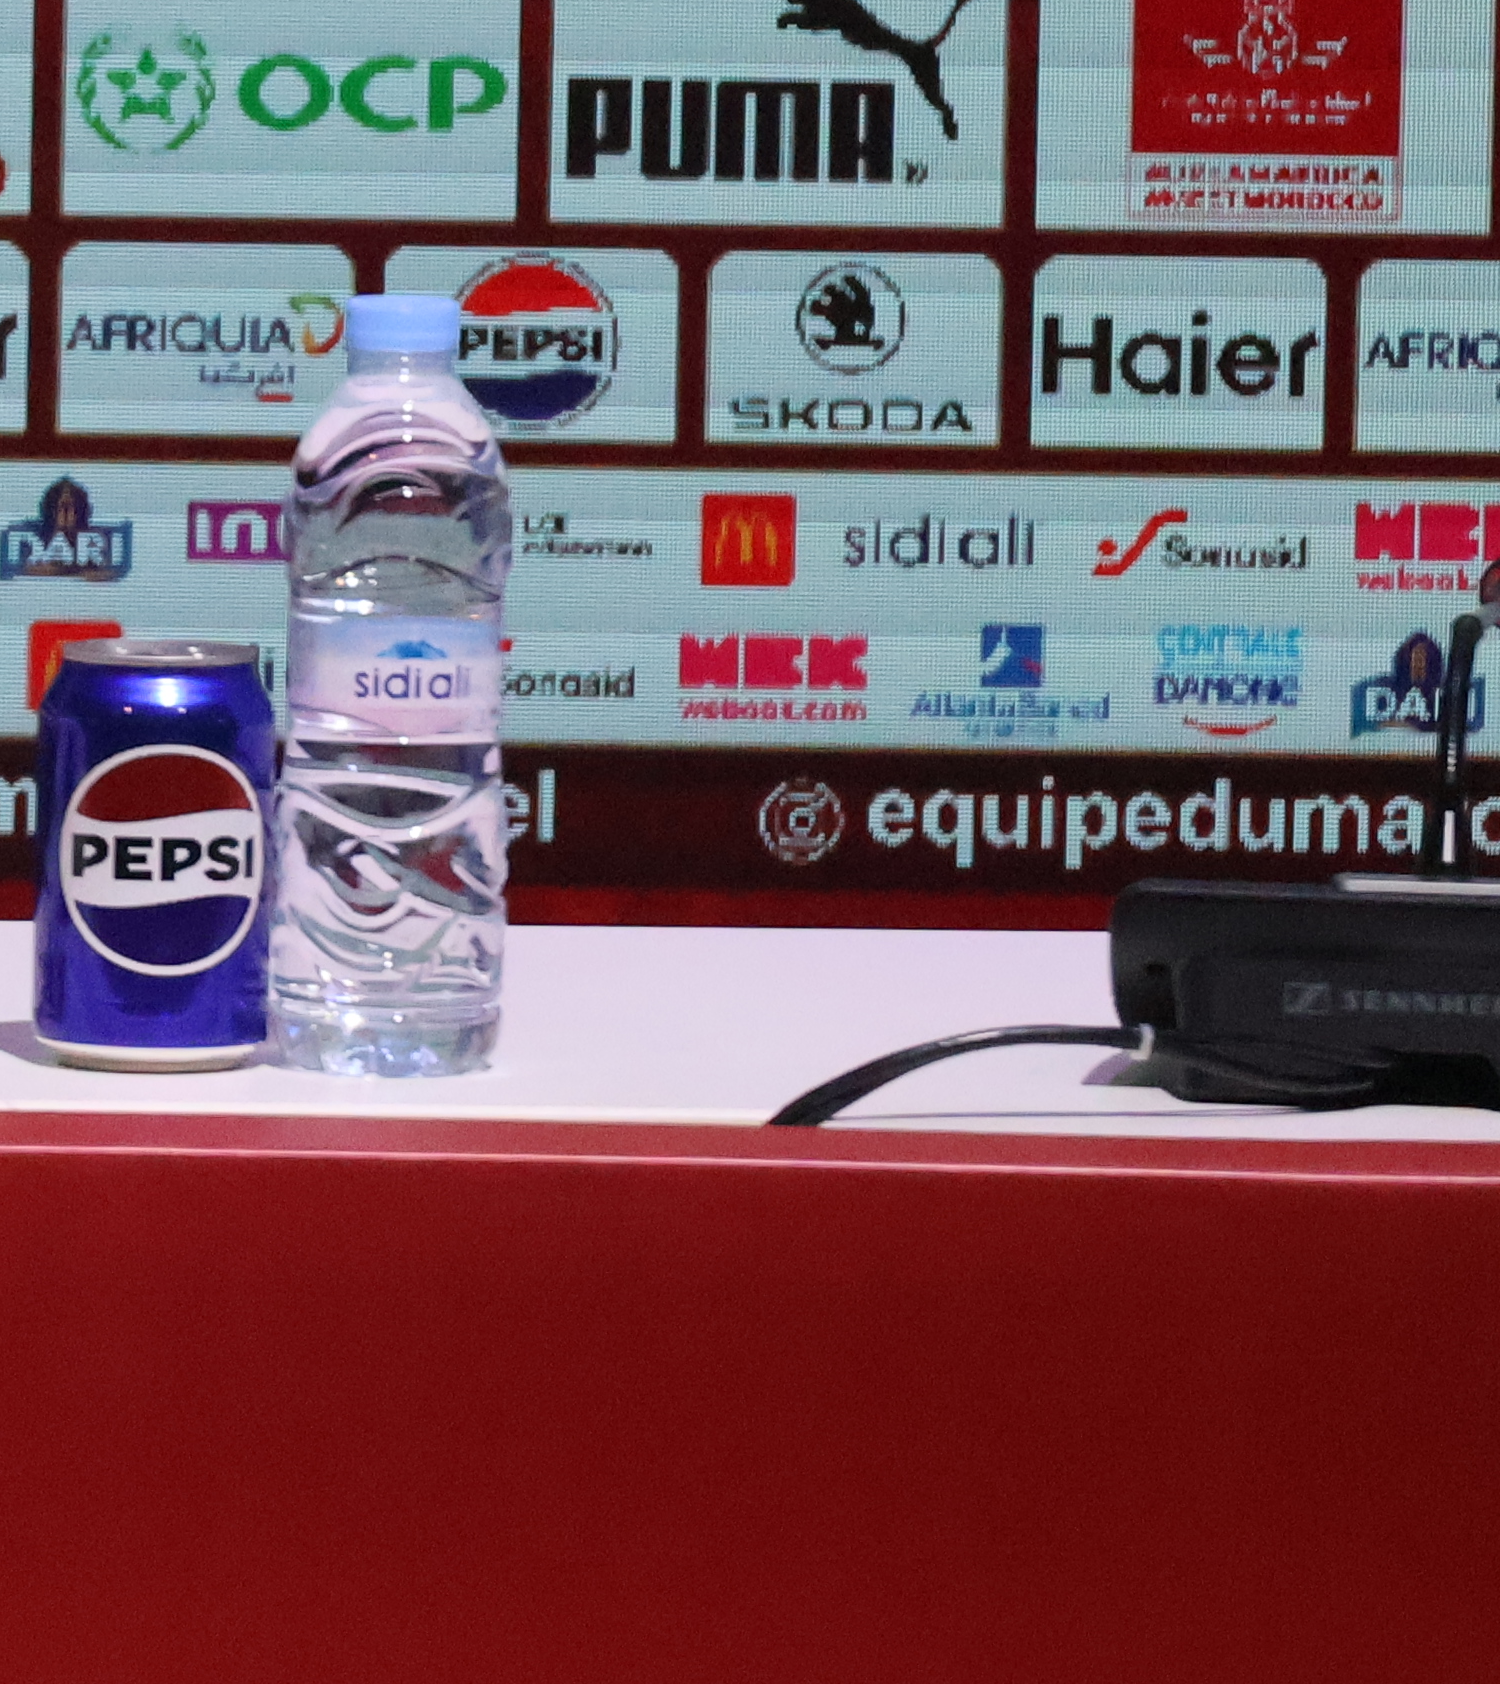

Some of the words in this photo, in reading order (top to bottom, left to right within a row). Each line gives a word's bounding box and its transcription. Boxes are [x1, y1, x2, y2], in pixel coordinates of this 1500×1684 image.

[237, 54, 507, 133] OCP
[566, 77, 894, 183] PUMA
[67, 314, 293, 353] AFRIQUIA
[459, 327, 602, 362] PEPSI
[1042, 311, 1318, 397] Haier
[7, 536, 128, 575] DARI
[354, 664, 422, 700] sidi
[72, 834, 254, 882] PEPSI
